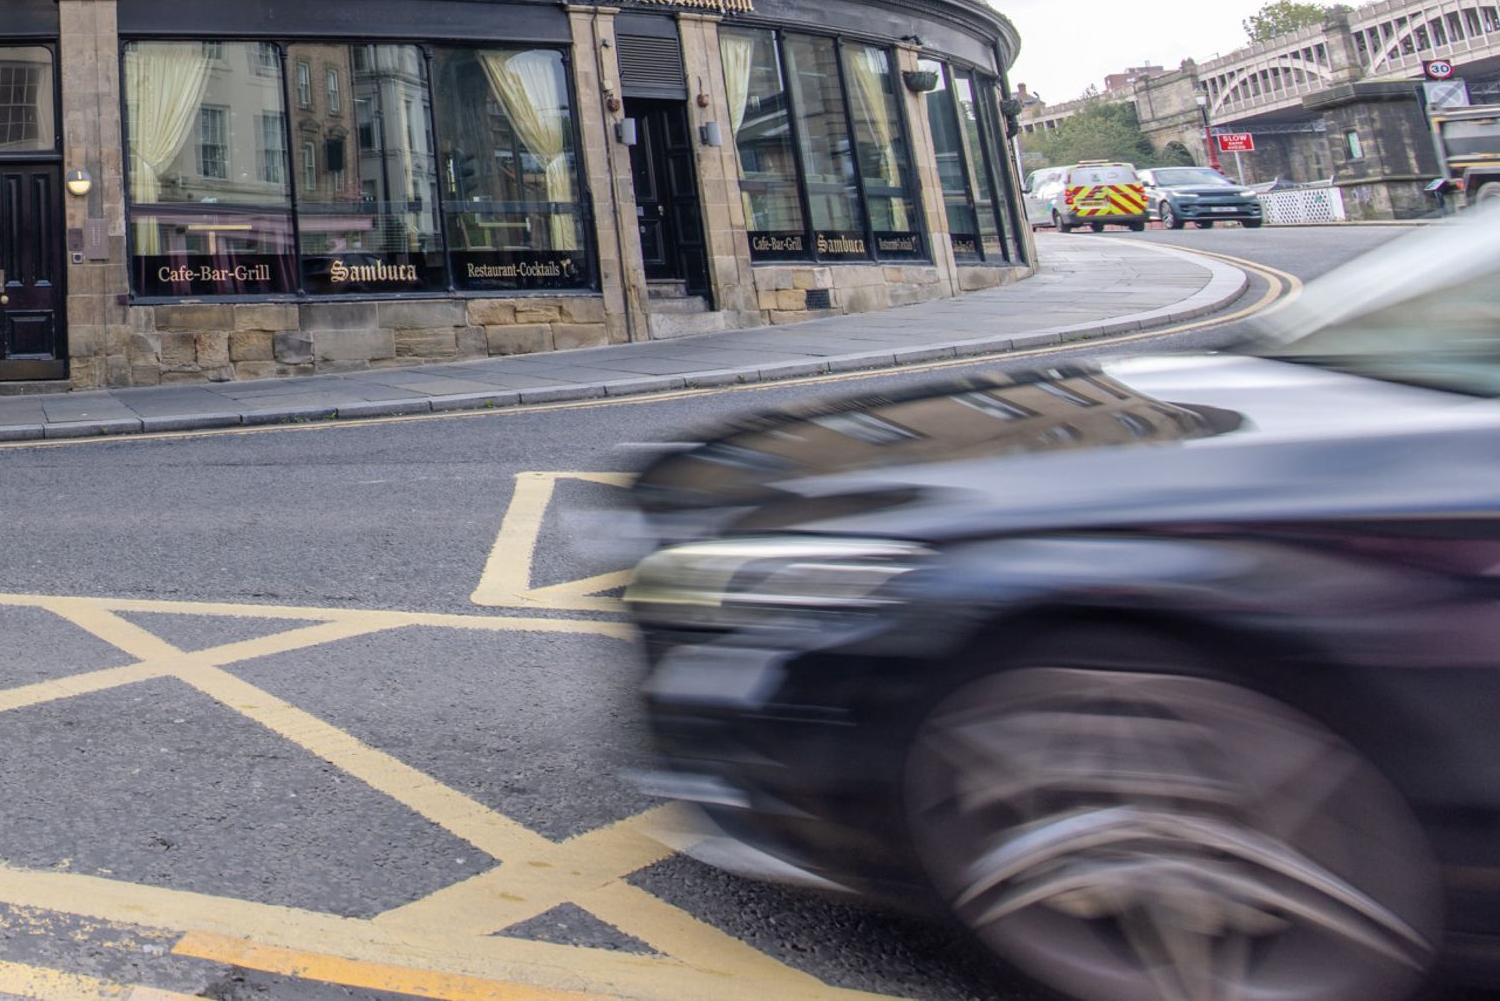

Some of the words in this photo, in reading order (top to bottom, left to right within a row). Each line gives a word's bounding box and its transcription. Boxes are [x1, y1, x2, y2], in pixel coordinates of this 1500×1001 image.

[1431, 65, 1450, 73] 30
[1222, 134, 1247, 142] SLOW
[817, 234, 865, 253] Sambuca
[157, 264, 271, 282] Cafe-Bar-Grill
[330, 258, 418, 283] Sambuca
[467, 261, 560, 278] Restaurant-Cocktails
